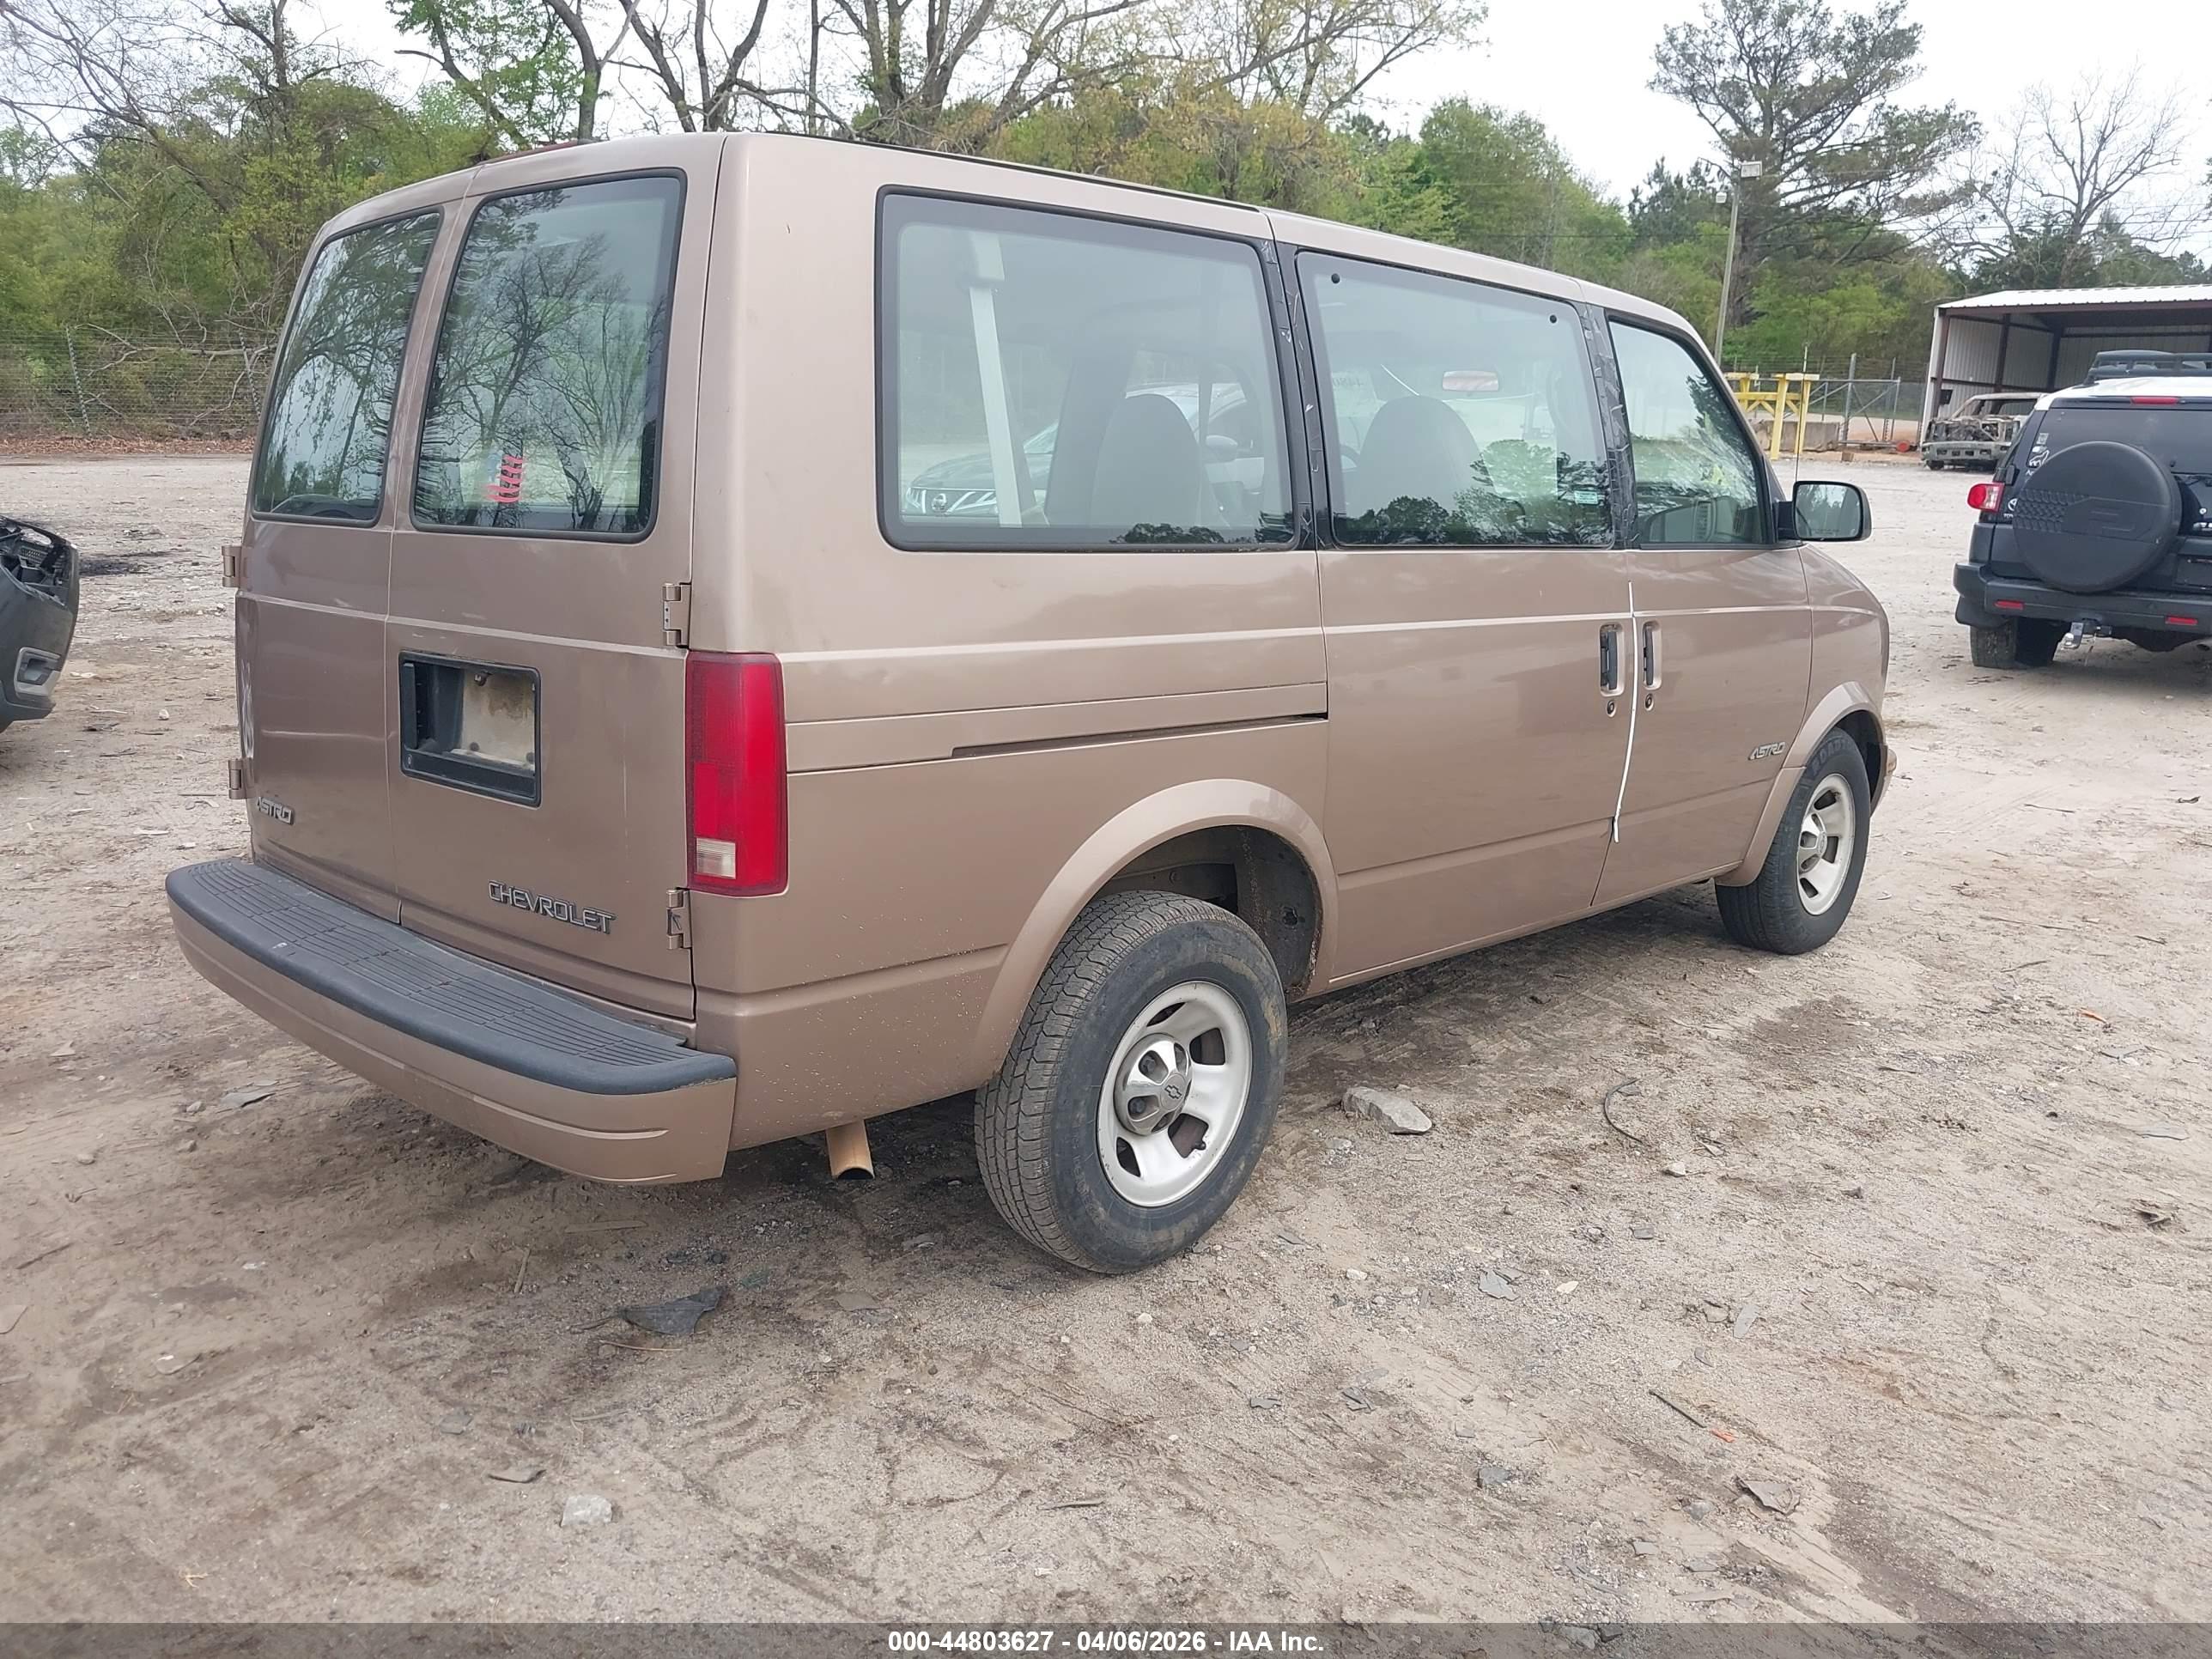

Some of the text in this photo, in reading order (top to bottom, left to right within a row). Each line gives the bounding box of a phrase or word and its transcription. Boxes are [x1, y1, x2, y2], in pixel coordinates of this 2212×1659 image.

[1748, 741, 1786, 761] ASTRO
[257, 796, 295, 826] ASTRO
[488, 879, 616, 934] CHEVROLET
